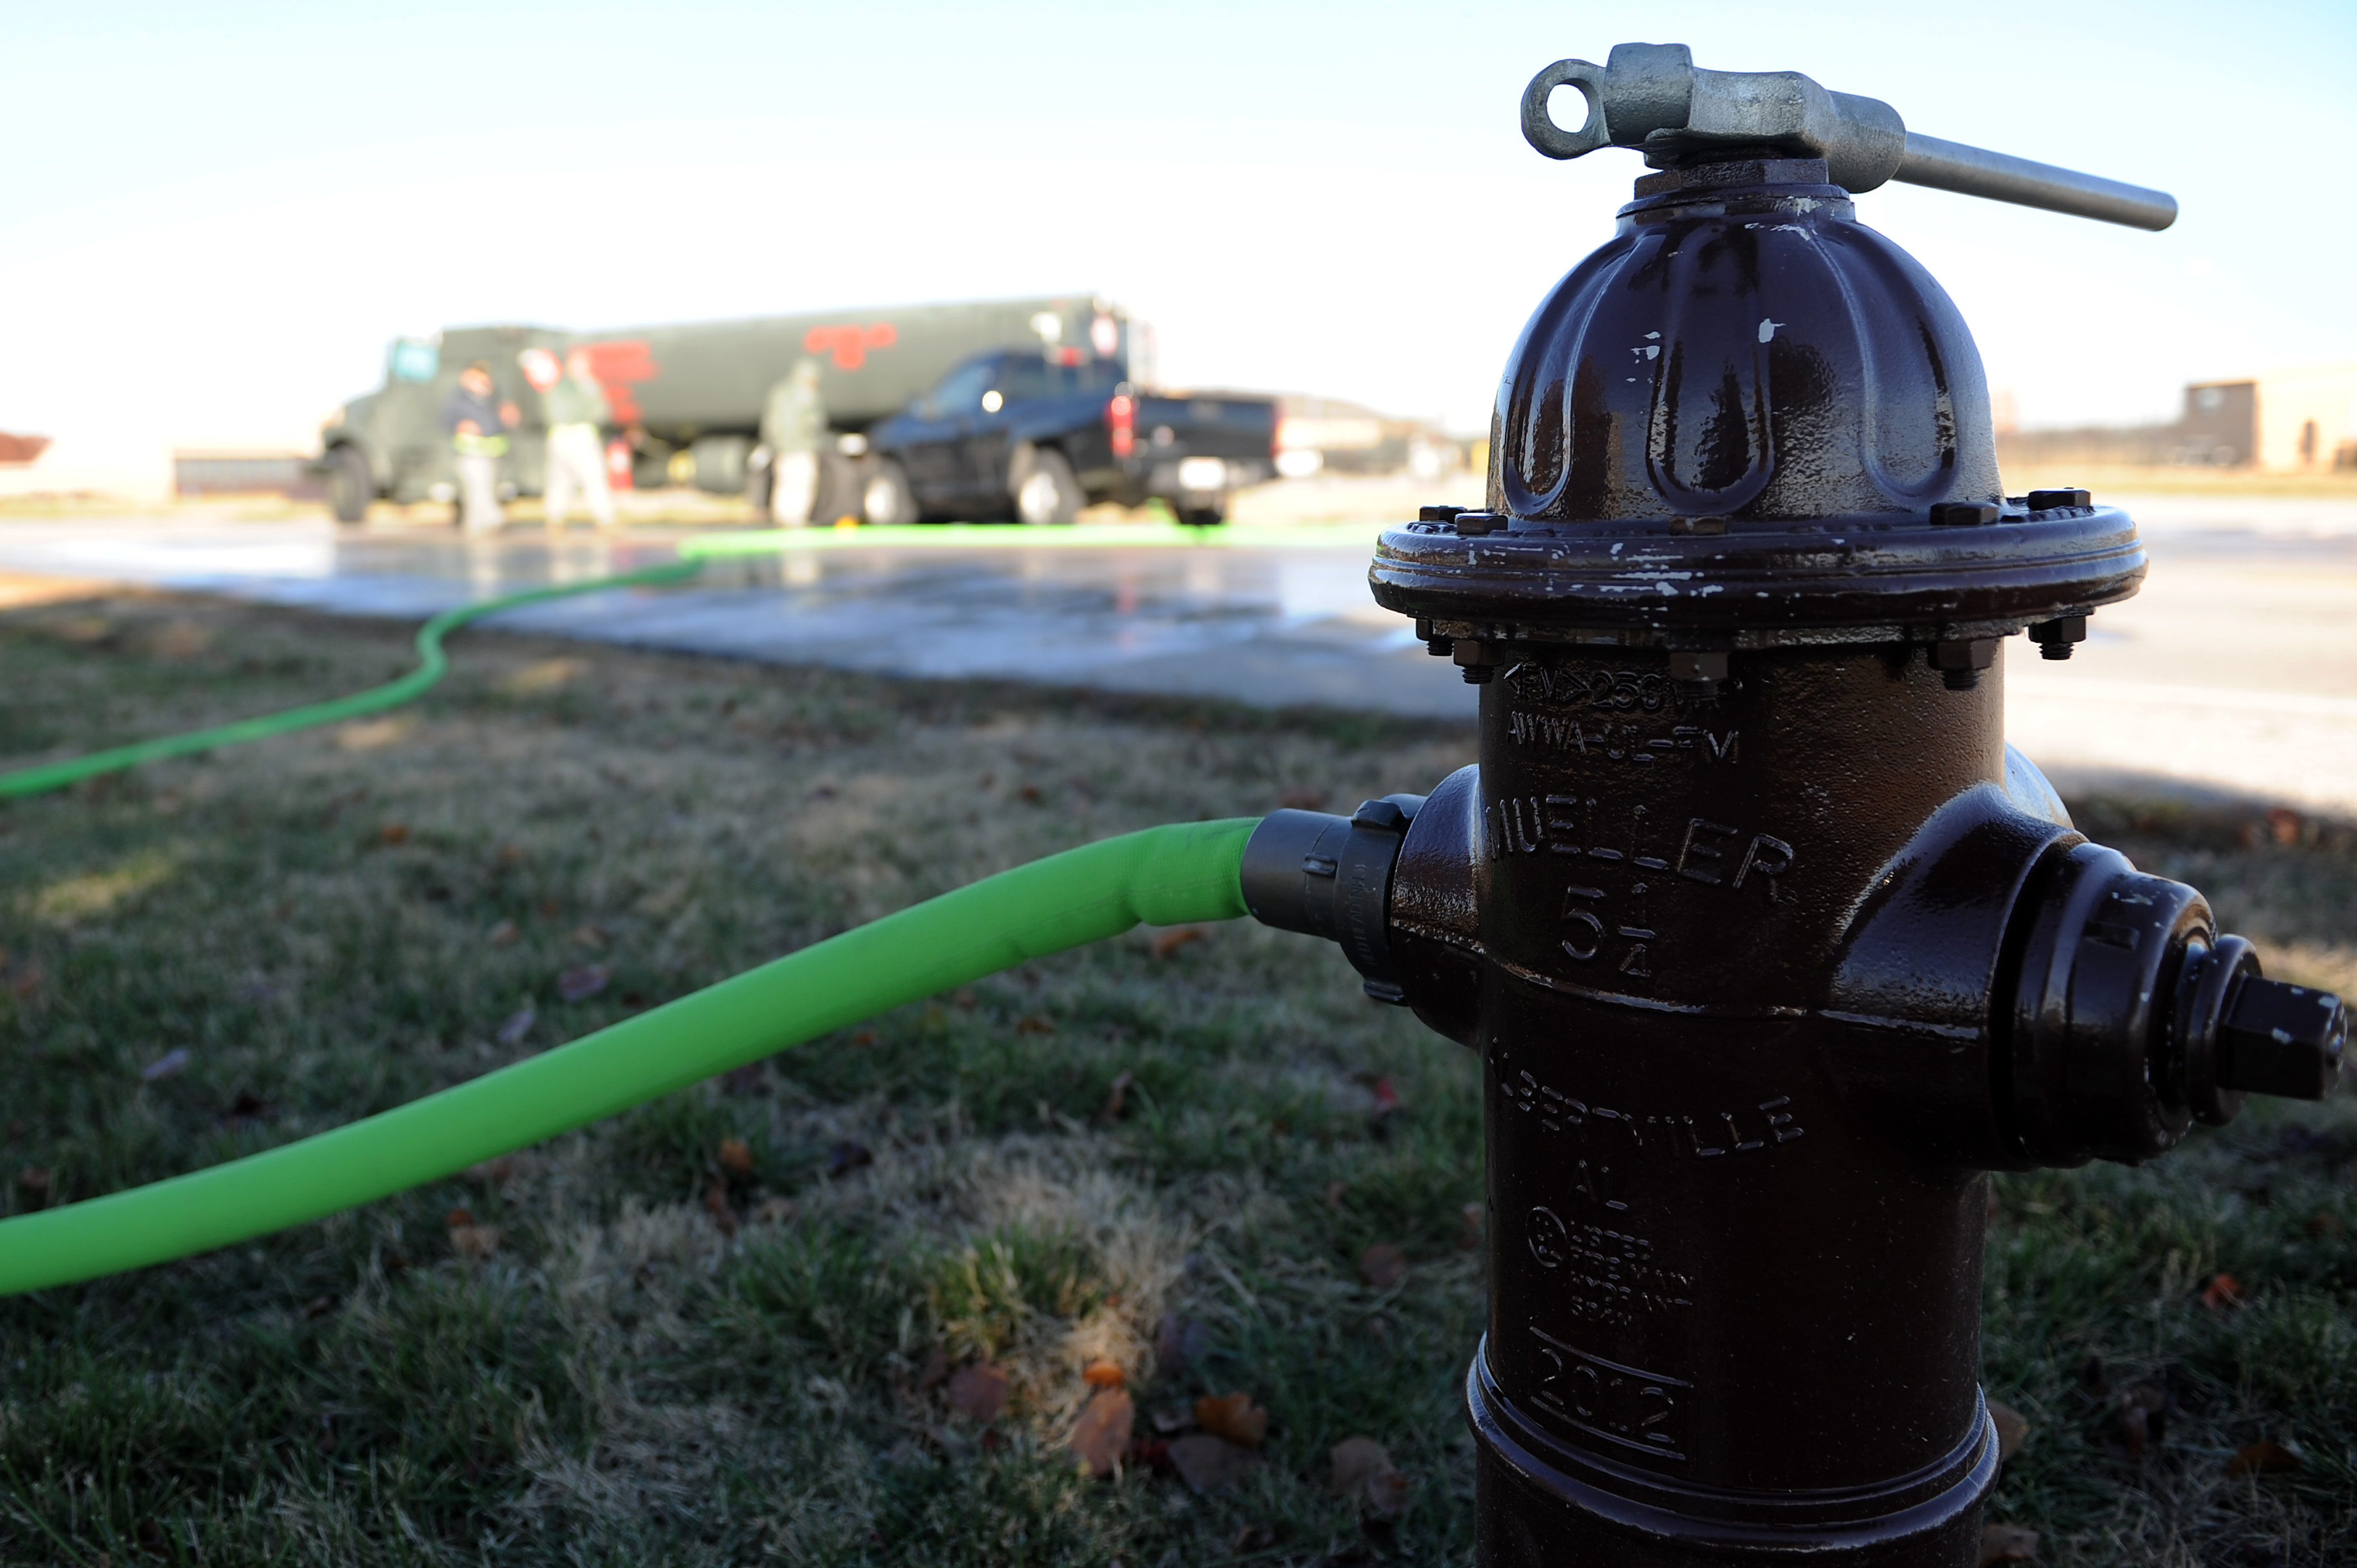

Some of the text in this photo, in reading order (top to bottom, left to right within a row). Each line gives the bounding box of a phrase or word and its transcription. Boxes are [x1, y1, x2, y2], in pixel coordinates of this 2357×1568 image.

[1485, 794, 1796, 905] MUELLER
[1561, 884, 1607, 962] 5
[1489, 1036, 1804, 1161] ALBERTVILLE
[1567, 1158, 1629, 1213] AL
[1539, 1347, 1676, 1445] 2012
